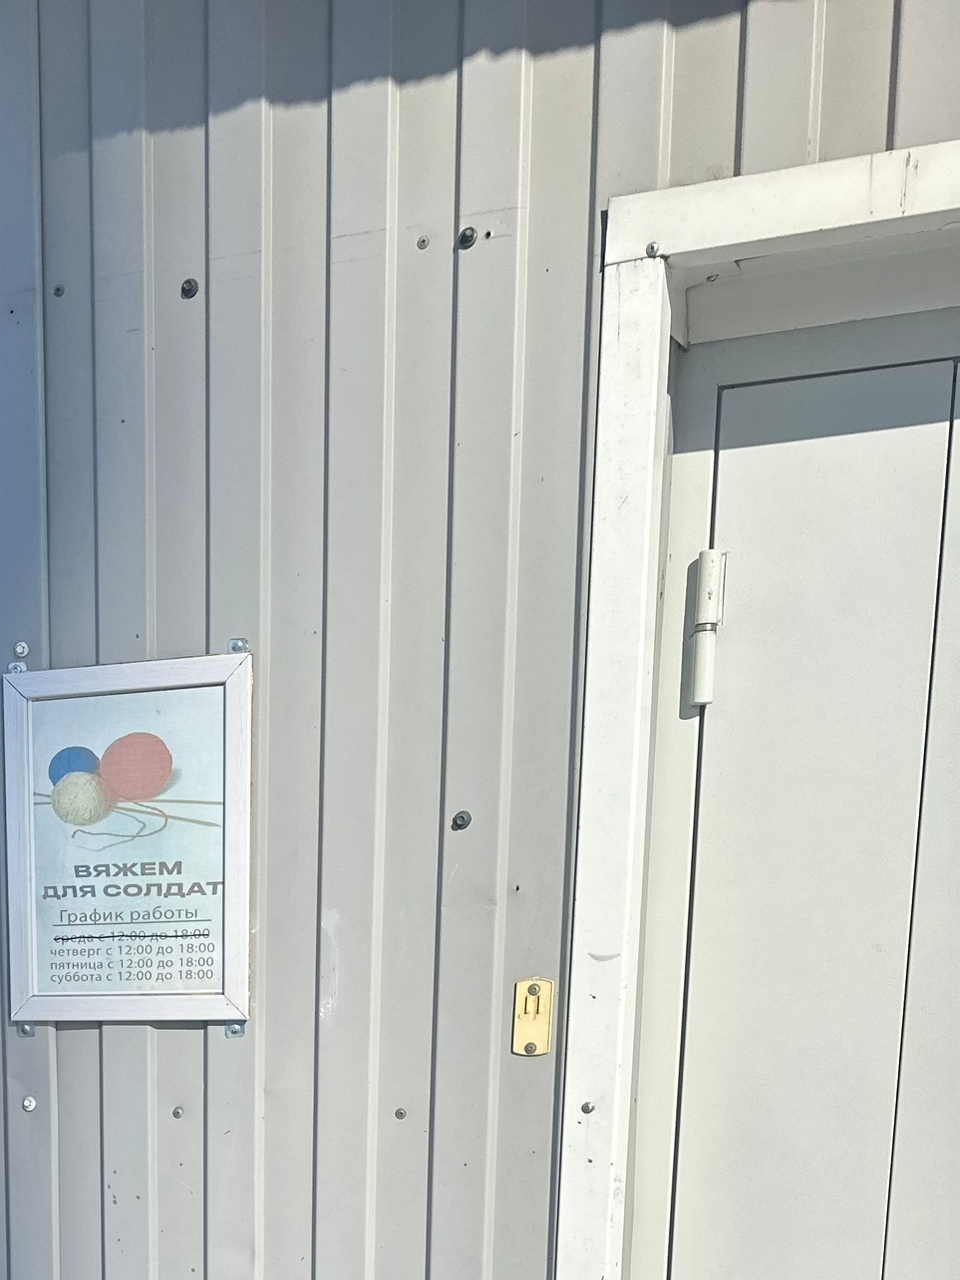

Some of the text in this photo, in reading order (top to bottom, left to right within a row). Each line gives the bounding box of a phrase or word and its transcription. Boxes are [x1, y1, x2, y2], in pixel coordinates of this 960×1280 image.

[74, 861, 182, 878] ВЯЖЕМ
[42, 881, 223, 900] ДЛЯ СОЛДАТ
[60, 906, 198, 925] График работы
[54, 928, 210, 945] среда с 12:00 до 18:00
[50, 942, 215, 958] четверг с 12:00 до 18:00
[50, 957, 214, 971] пятница с 12:00 до 18:00
[50, 970, 213, 984] суббота с 12:00 до 18:00
